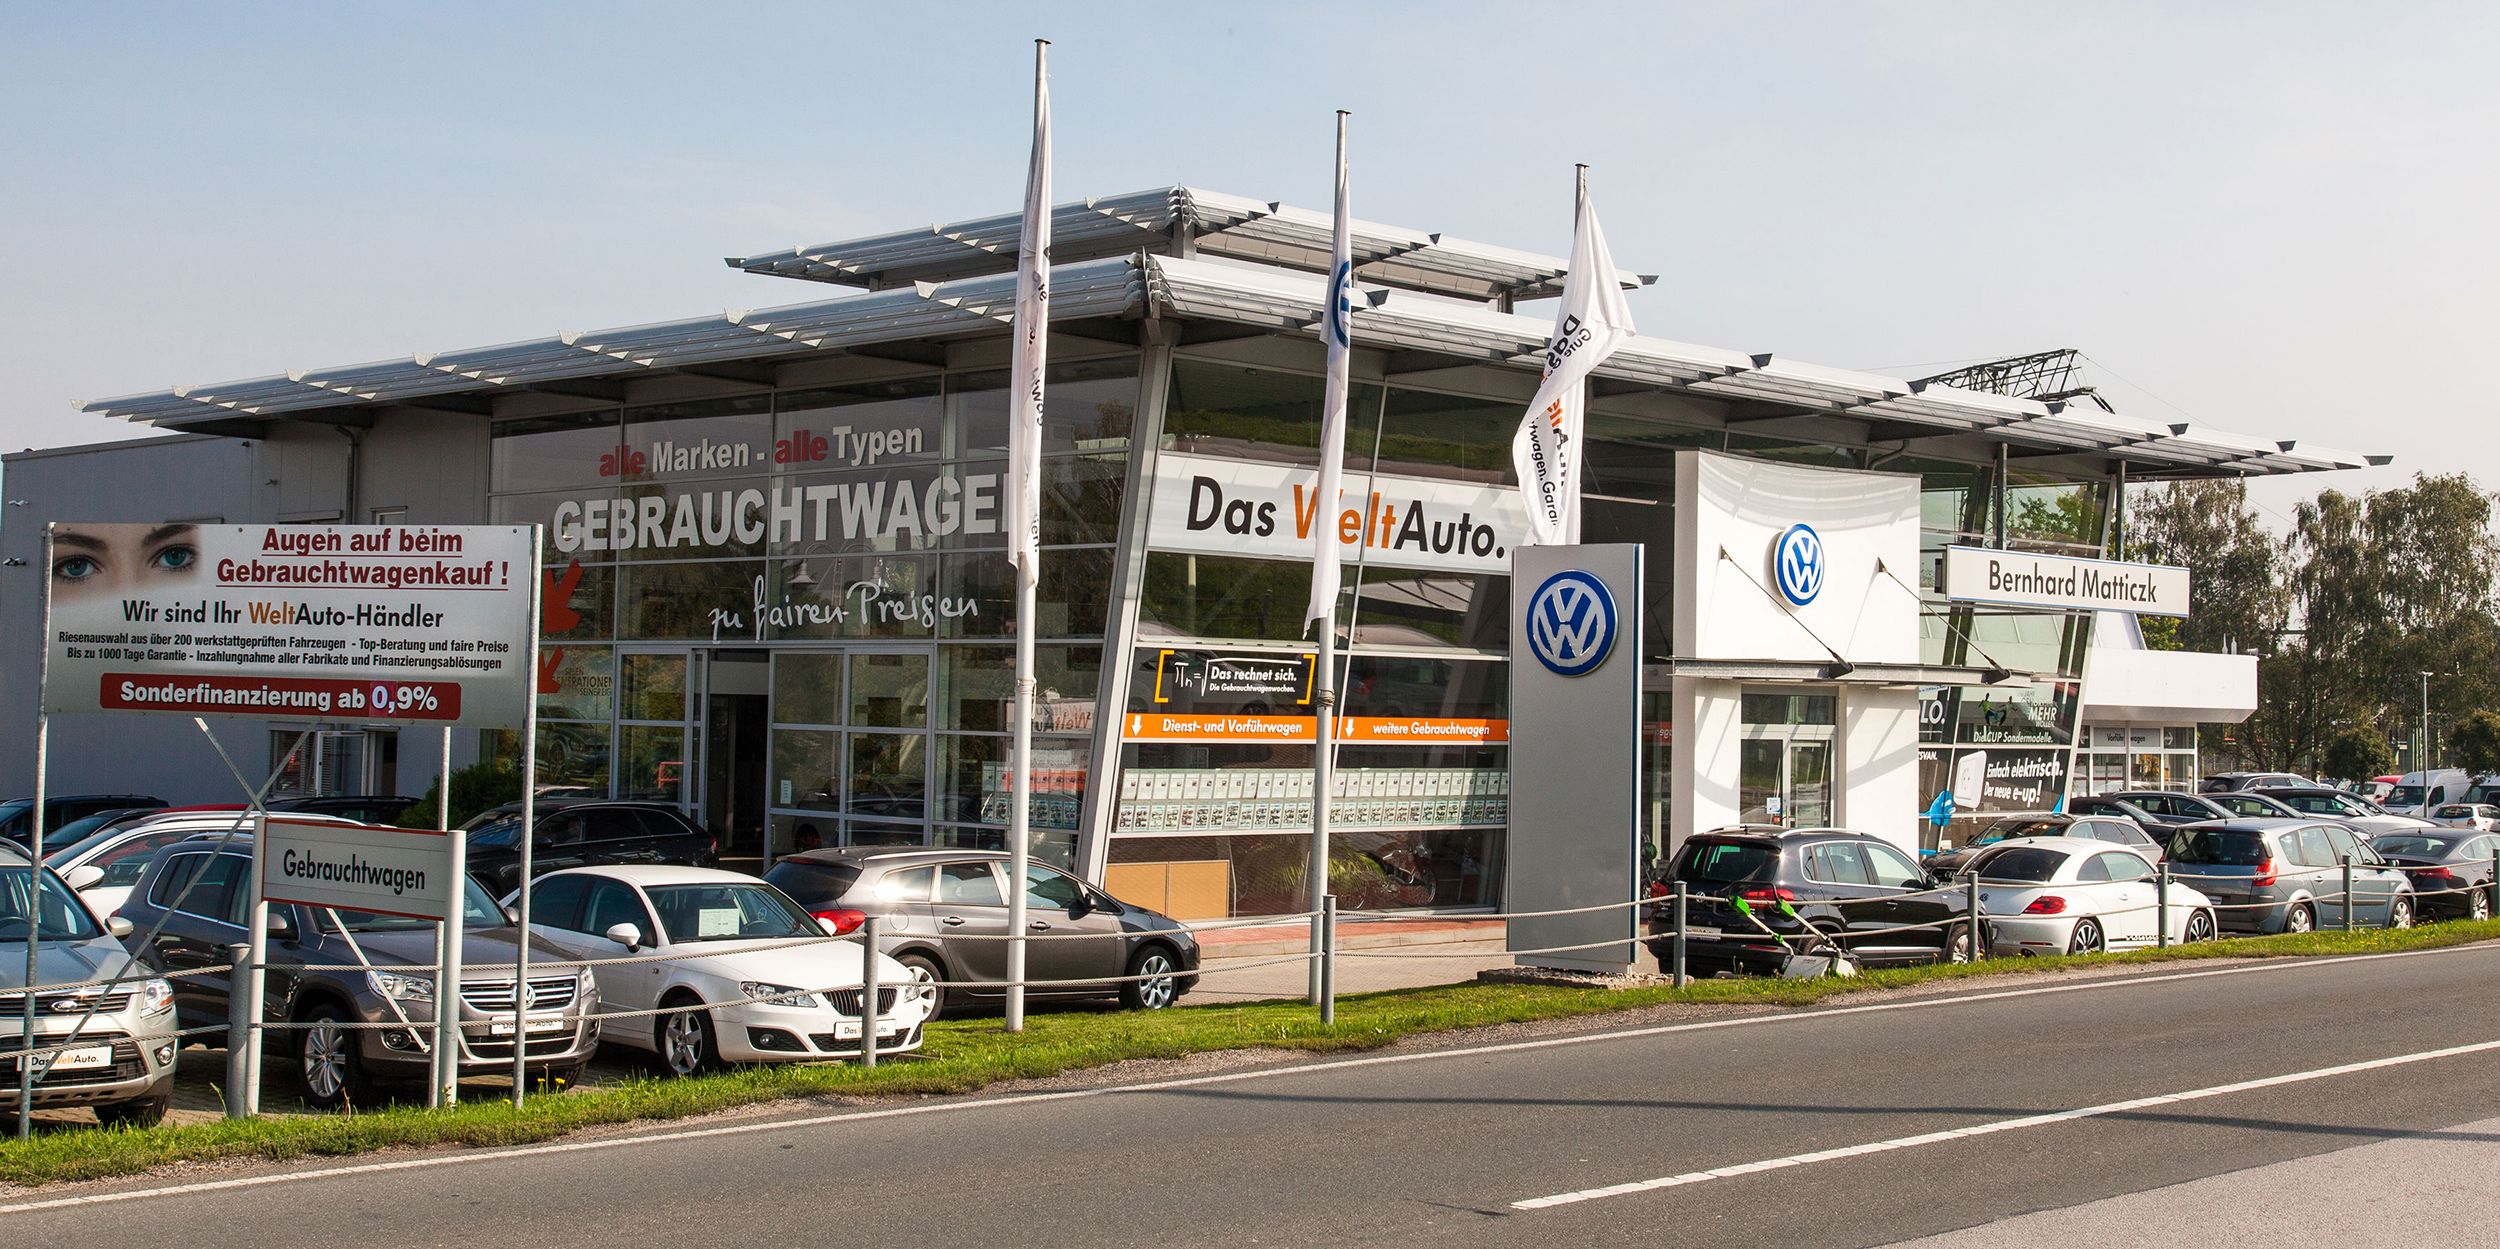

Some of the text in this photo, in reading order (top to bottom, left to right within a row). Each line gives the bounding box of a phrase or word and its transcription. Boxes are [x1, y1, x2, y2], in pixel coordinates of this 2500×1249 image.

[600, 425, 923, 477] alle Marken - alle Typen
[553, 473, 1010, 553] GEBRAUCHTWAGE
[1186, 475, 1277, 538] Das
[262, 528, 463, 556] Augen auf beim
[217, 558, 509, 588] Gebrauchtwagenkauf !
[1989, 560, 2157, 603] Bernhard Matticzk
[122, 600, 444, 628] Wir sind Ihr WeltAuto-Händler
[708, 575, 978, 644] zu fairen Preisen
[58, 631, 129, 644] Riesenauswahl
[131, 634, 148, 645] aus
[150, 633, 171, 646] über
[174, 634, 192, 646] 200
[195, 635, 287, 649] werkstattgeprüften
[289, 636, 346, 651] Fahrzeugen
[359, 637, 426, 653] Top-Beratung
[428, 639, 448, 651] und
[450, 640, 474, 652] faire
[477, 641, 509, 653] Preise
[67, 647, 82, 658] Bis
[84, 649, 95, 659] zu
[98, 648, 121, 659] 1000
[124, 649, 145, 662] Tage
[147, 649, 187, 661] Garantie
[196, 650, 276, 664] Inzahlungnahme
[278, 651, 300, 664] aller
[302, 652, 348, 665] Fabrikate
[351, 654, 370, 666] und
[373, 654, 502, 671] Finanzierungsablösungen
[1211, 667, 1231, 680] Das
[1234, 667, 1273, 681] rechnet
[1274, 668, 1297, 681] sich.
[120, 681, 438, 714] Sonderfinanzierung ab 0,9%
[1209, 683, 1218, 692] Die
[1919, 700, 1945, 725] LO.
[2028, 707, 2057, 720] MEHR
[1163, 719, 1302, 735] Dienst- und Vorführwagen
[1373, 722, 1490, 737] weitere Gebrauchtwagen
[2003, 731, 2053, 743] Sondermodelle.
[1987, 753, 2063, 778] Einfach elektrisch.
[1984, 780, 2042, 808] Der neue e-up!
[283, 849, 425, 895] Gebrauchtwagen
[844, 1026, 857, 1034] Das
